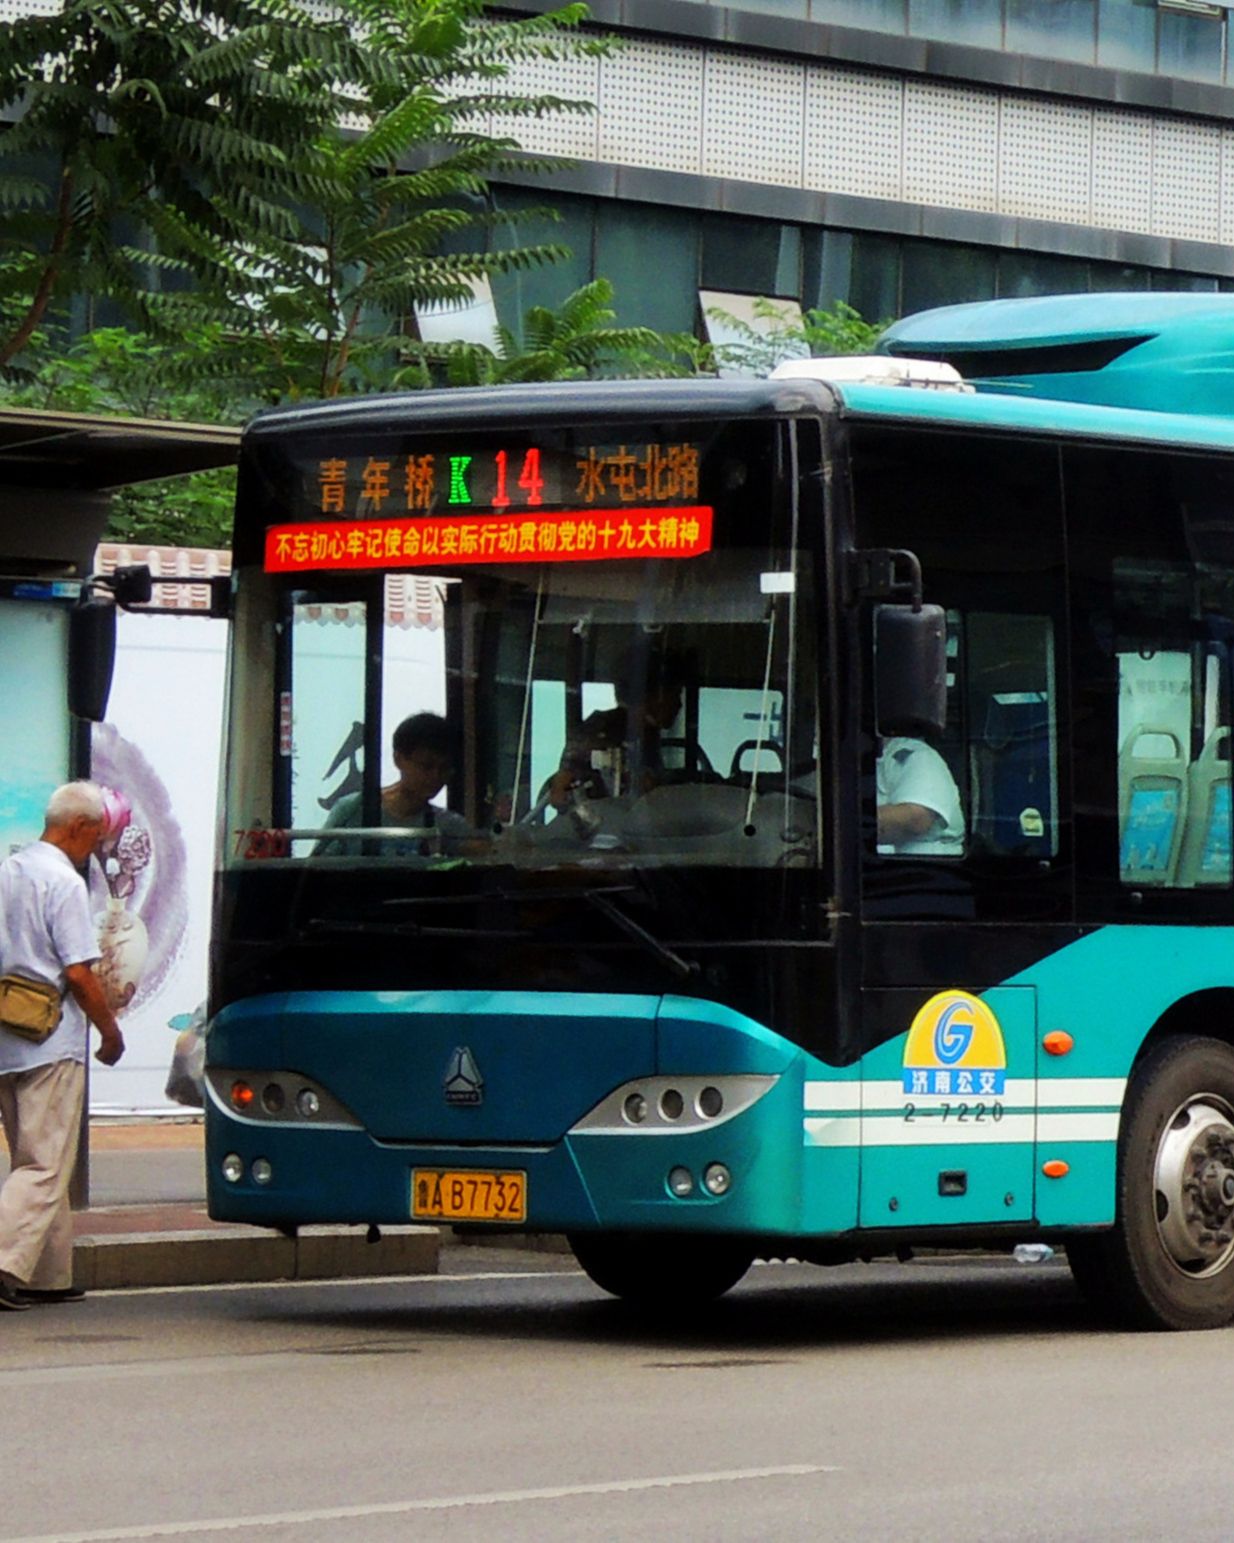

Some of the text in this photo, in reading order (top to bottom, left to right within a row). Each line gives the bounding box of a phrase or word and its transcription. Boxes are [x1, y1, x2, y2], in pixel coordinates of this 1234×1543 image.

[318, 443, 699, 513] 青年桥 K 14 水屯北路
[275, 517, 700, 562] 不忘初心牢记使命以实际行动贯彻党的十九大精神
[911, 1070, 996, 1094] 济南公交
[903, 1101, 1004, 1123] 2-7220
